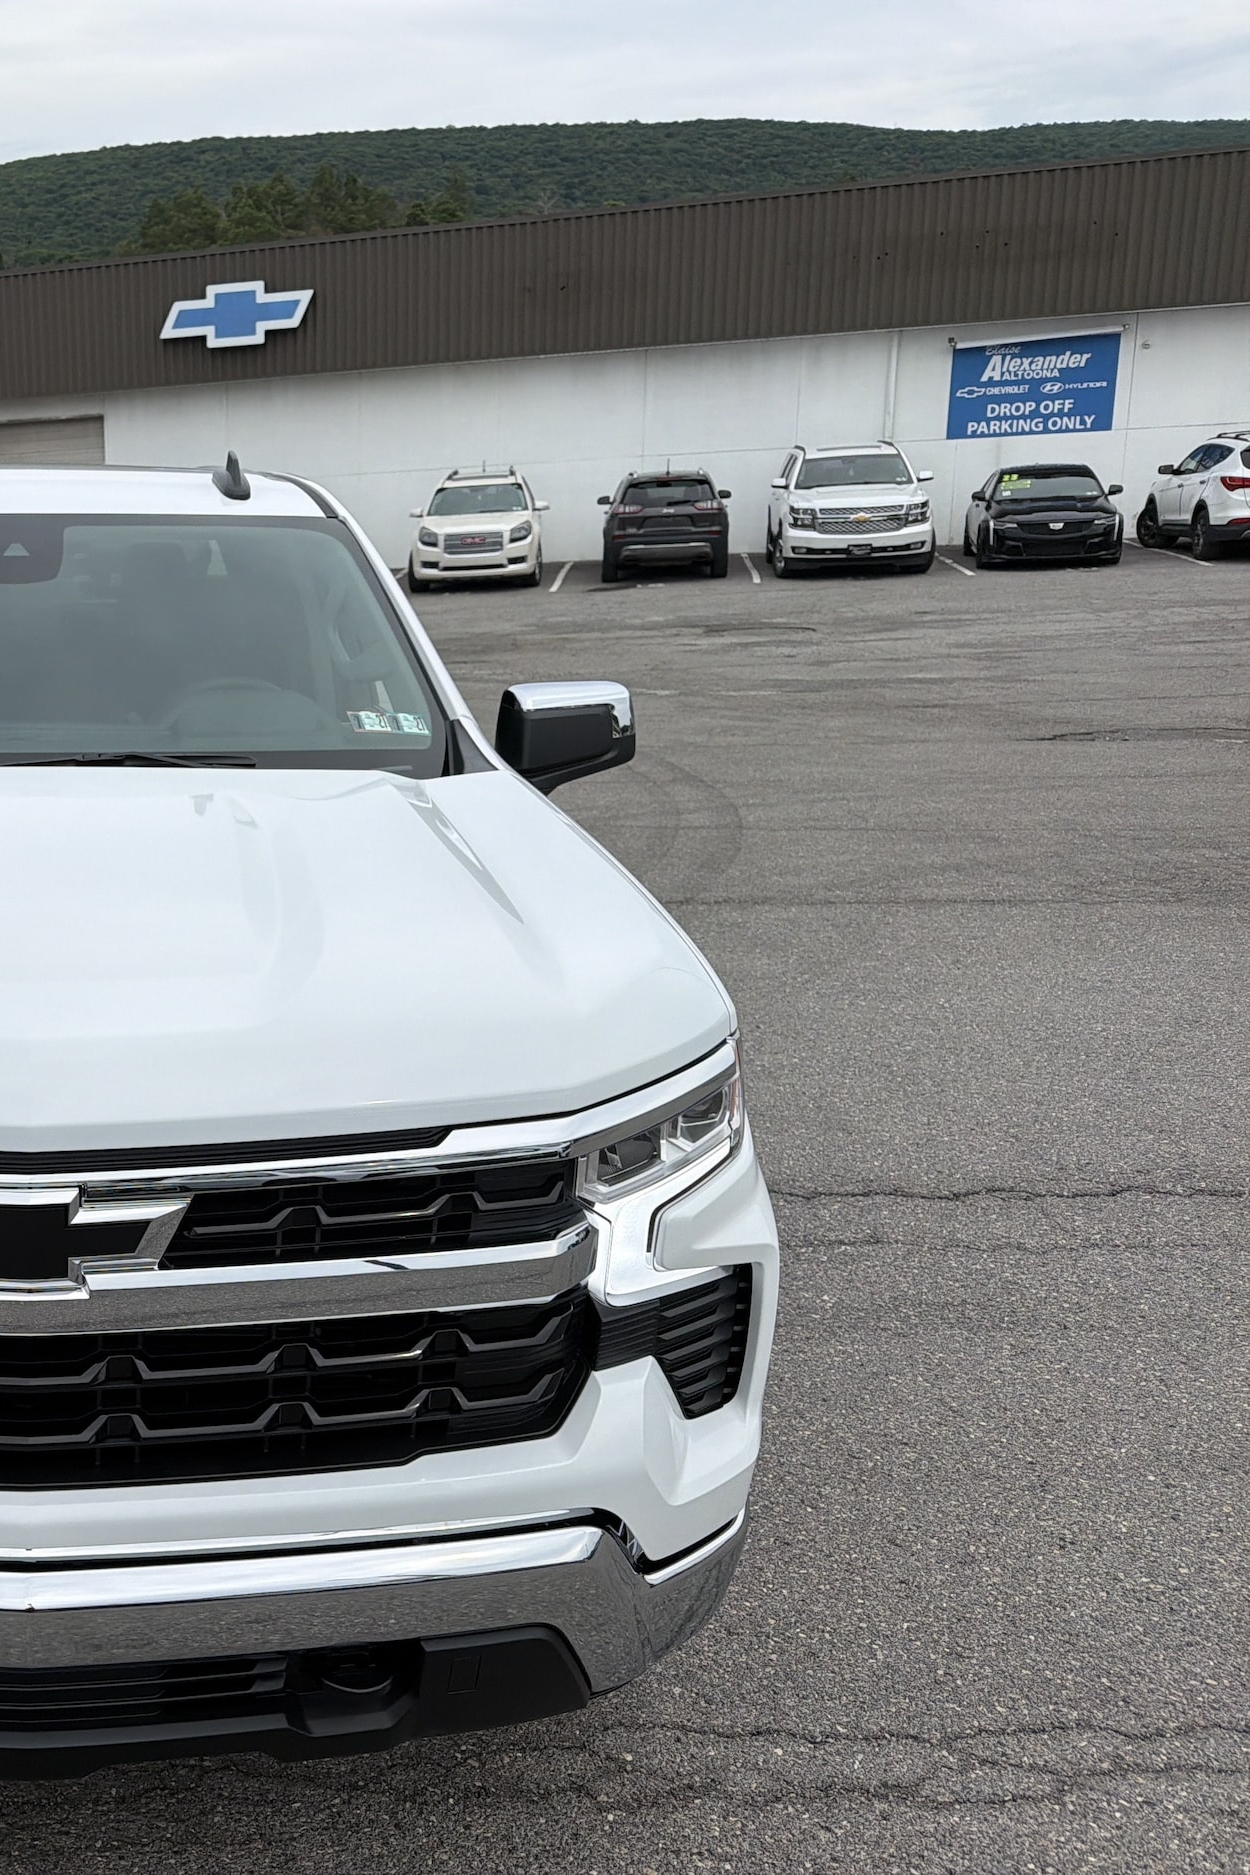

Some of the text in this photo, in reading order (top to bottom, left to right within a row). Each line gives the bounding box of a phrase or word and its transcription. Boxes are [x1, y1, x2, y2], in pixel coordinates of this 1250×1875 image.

[980, 351, 1091, 381] Alexander
[1002, 369, 1059, 380] ALTOONA
[986, 385, 1029, 395] CHEVROLET
[1066, 382, 1107, 390] HYUNDAI
[986, 400, 1074, 417] DROP OFF
[967, 416, 1095, 435] PARKING ONLY
